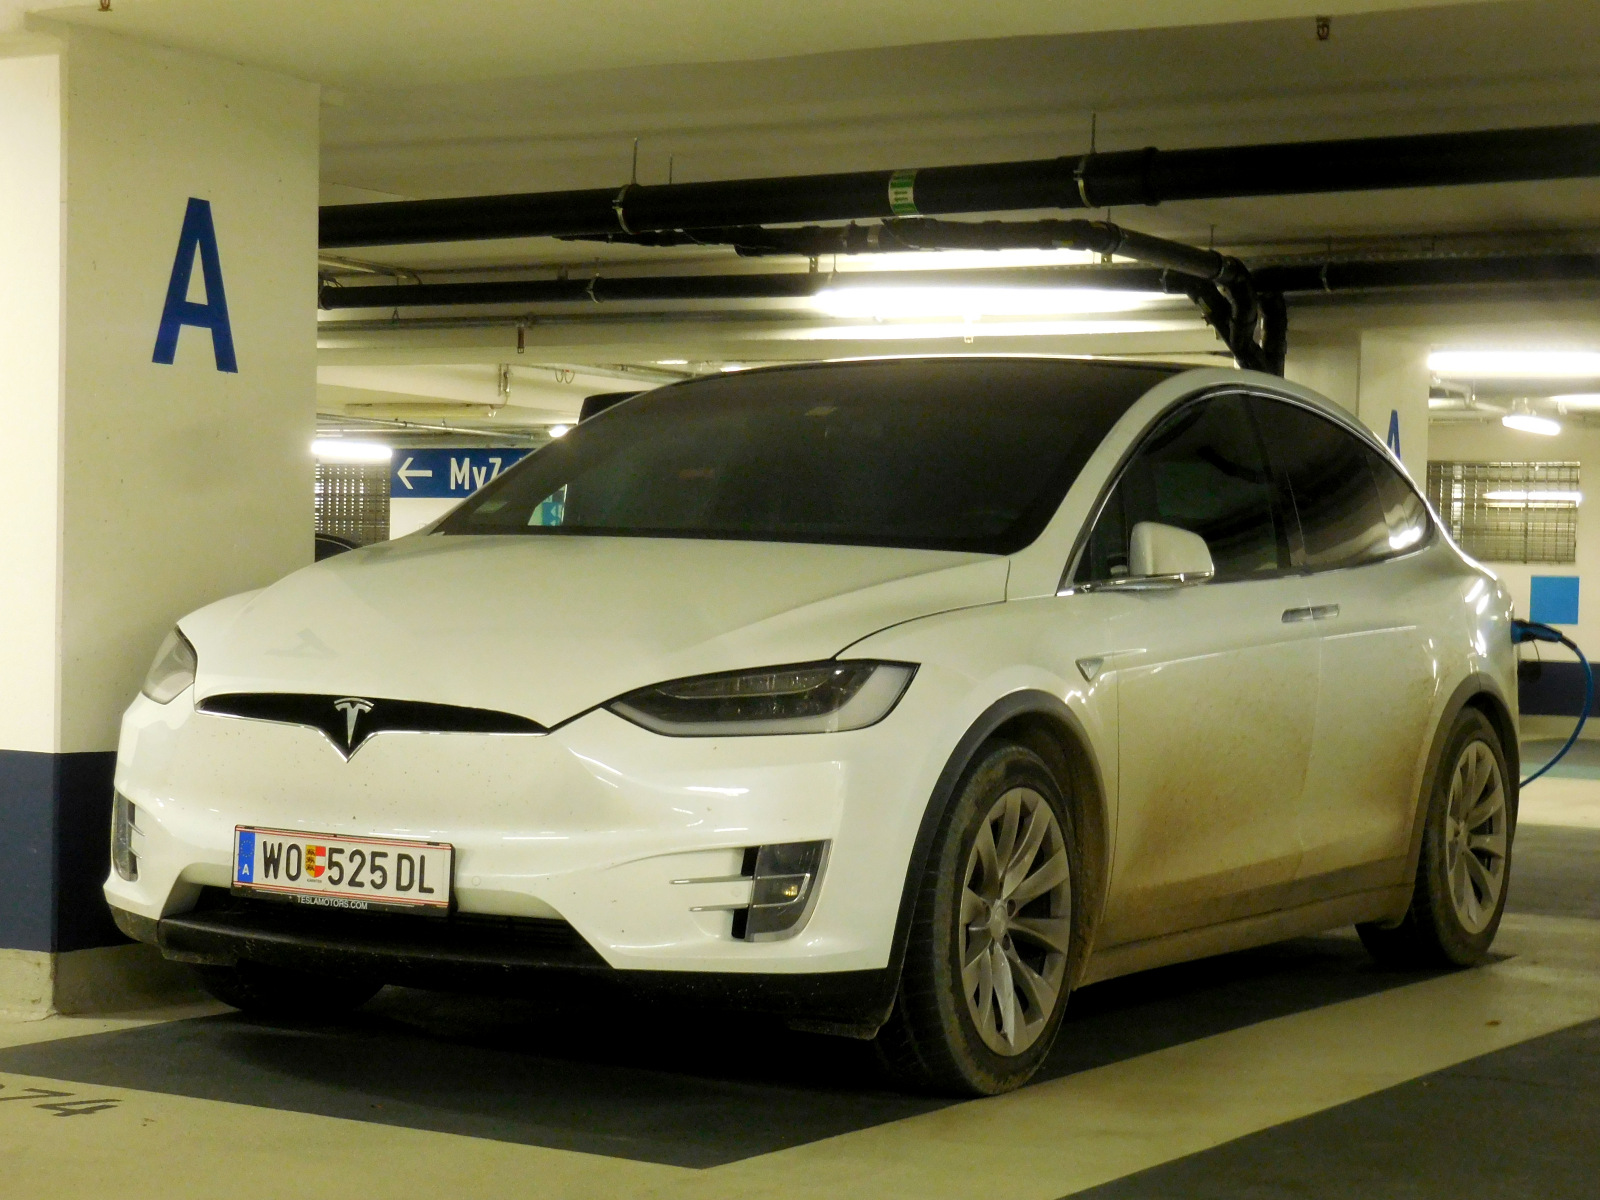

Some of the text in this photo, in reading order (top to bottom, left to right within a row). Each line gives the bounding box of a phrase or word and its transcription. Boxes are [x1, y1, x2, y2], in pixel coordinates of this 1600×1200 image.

[152, 196, 238, 374] A
[241, 863, 250, 876] A
[262, 840, 435, 894] WO 525 DL
[296, 895, 368, 910] TESLAMOTORS.COM
[0, 1083, 123, 1117] 74
